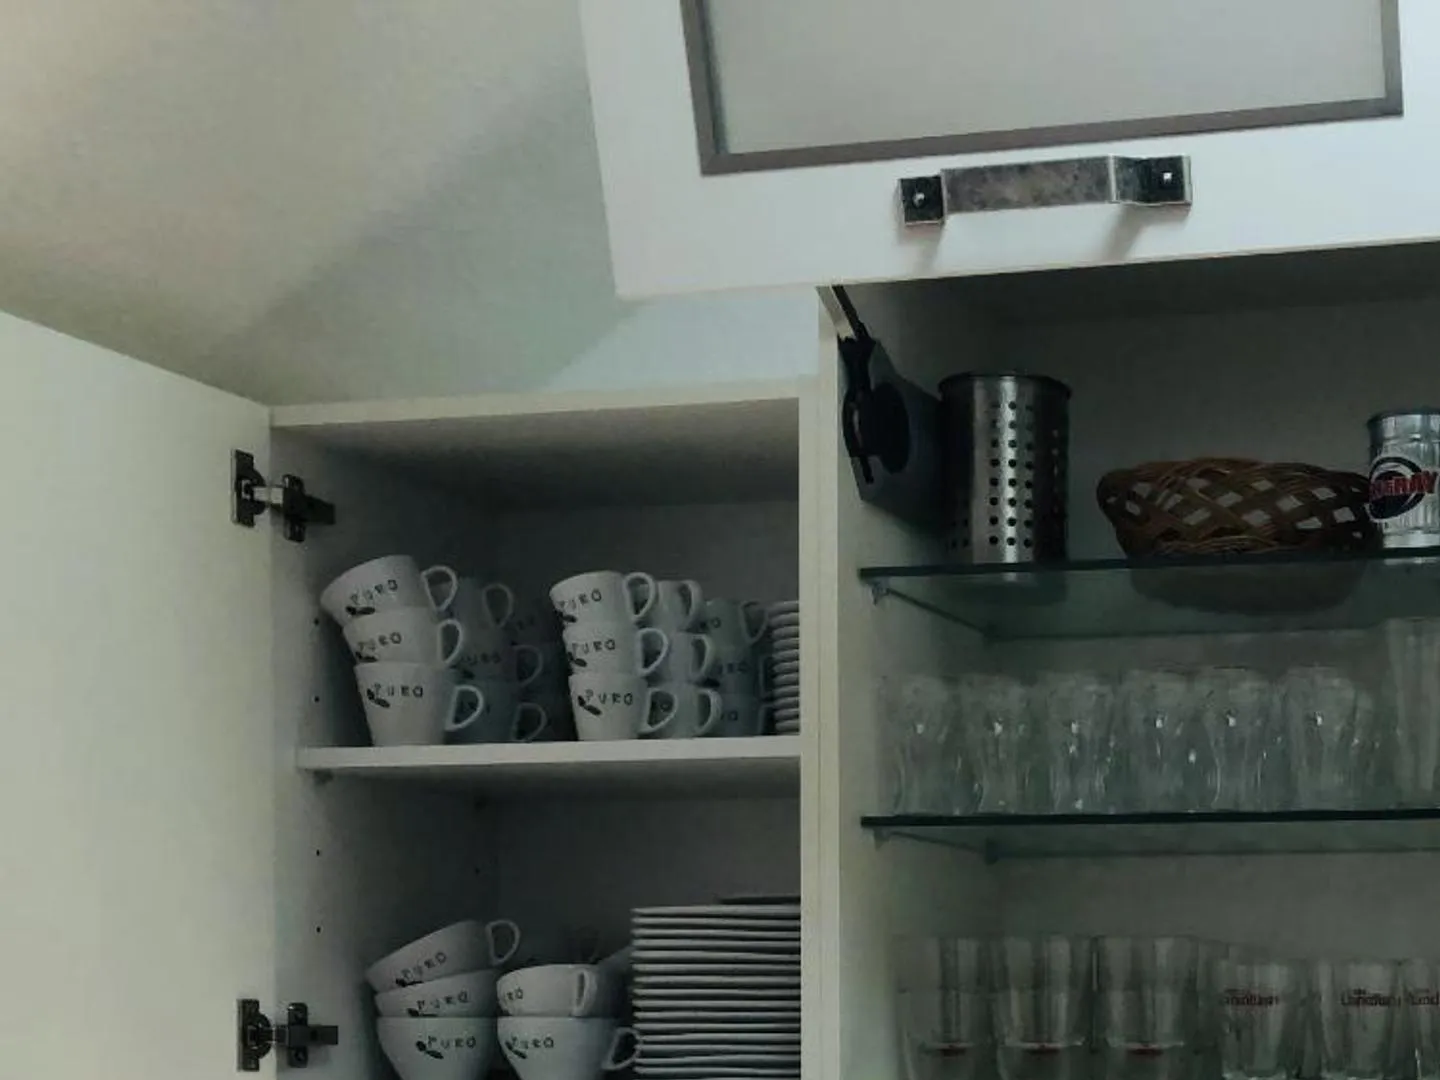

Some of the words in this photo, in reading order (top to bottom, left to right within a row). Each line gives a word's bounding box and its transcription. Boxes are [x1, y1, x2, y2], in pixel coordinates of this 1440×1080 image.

[373, 683, 425, 699] PURO
[584, 689, 634, 707] PURO
[427, 1035, 477, 1050] PURO
